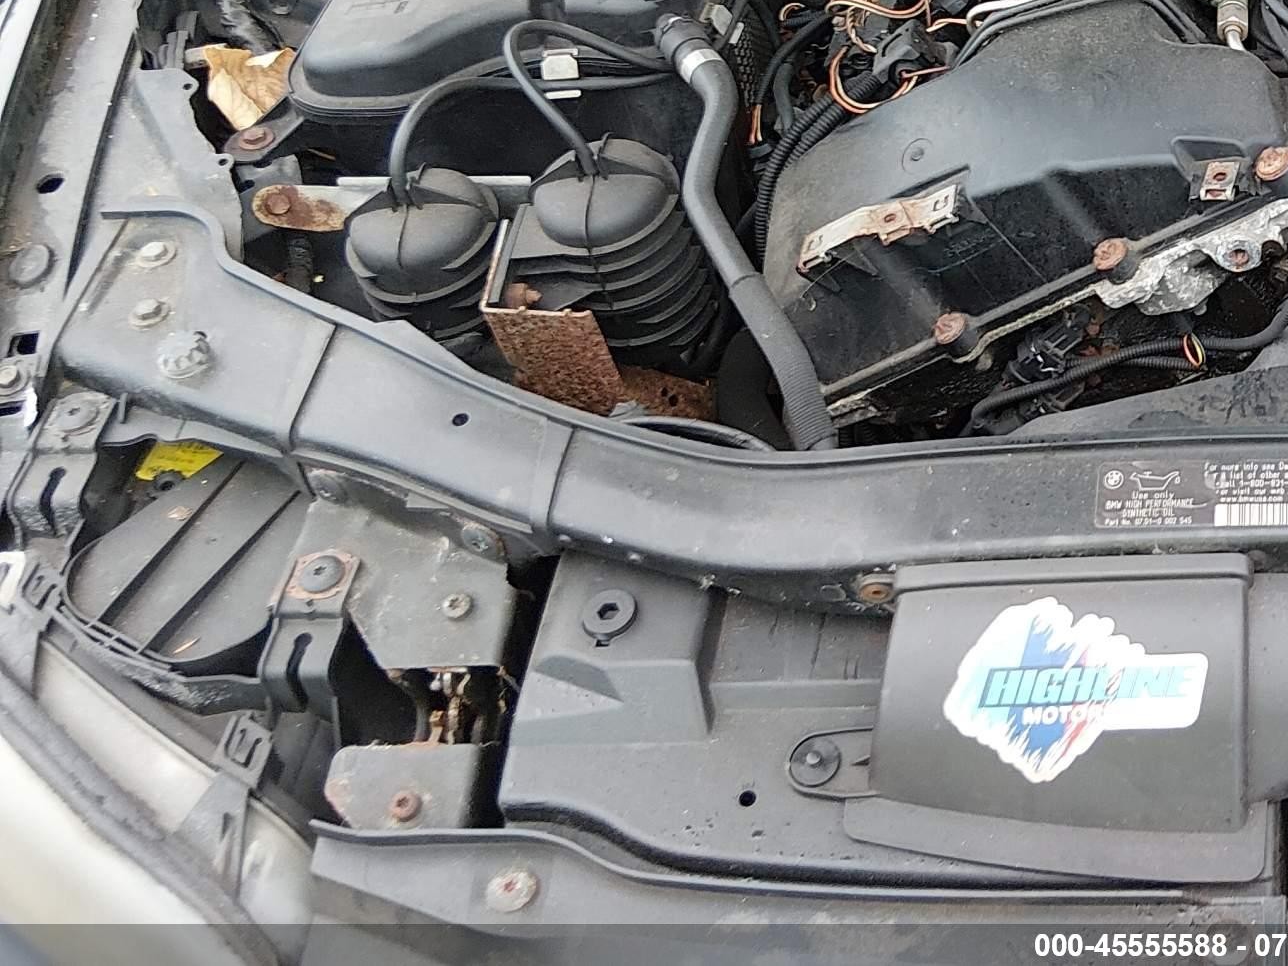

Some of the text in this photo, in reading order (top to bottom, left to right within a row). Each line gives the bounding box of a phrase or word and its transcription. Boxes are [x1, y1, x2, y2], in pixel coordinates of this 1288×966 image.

[1243, 462, 1258, 471] info
[1247, 471, 1256, 479] of
[1260, 471, 1280, 479] other
[1232, 486, 1250, 495] visit
[1270, 486, 1285, 495] web
[1132, 490, 1175, 502] Use only
[1104, 497, 1194, 510] BMW HIGH PERFORMANCE
[1122, 507, 1175, 517] SYNTHETIC OIL
[978, 665, 1195, 708] HIGHLINE
